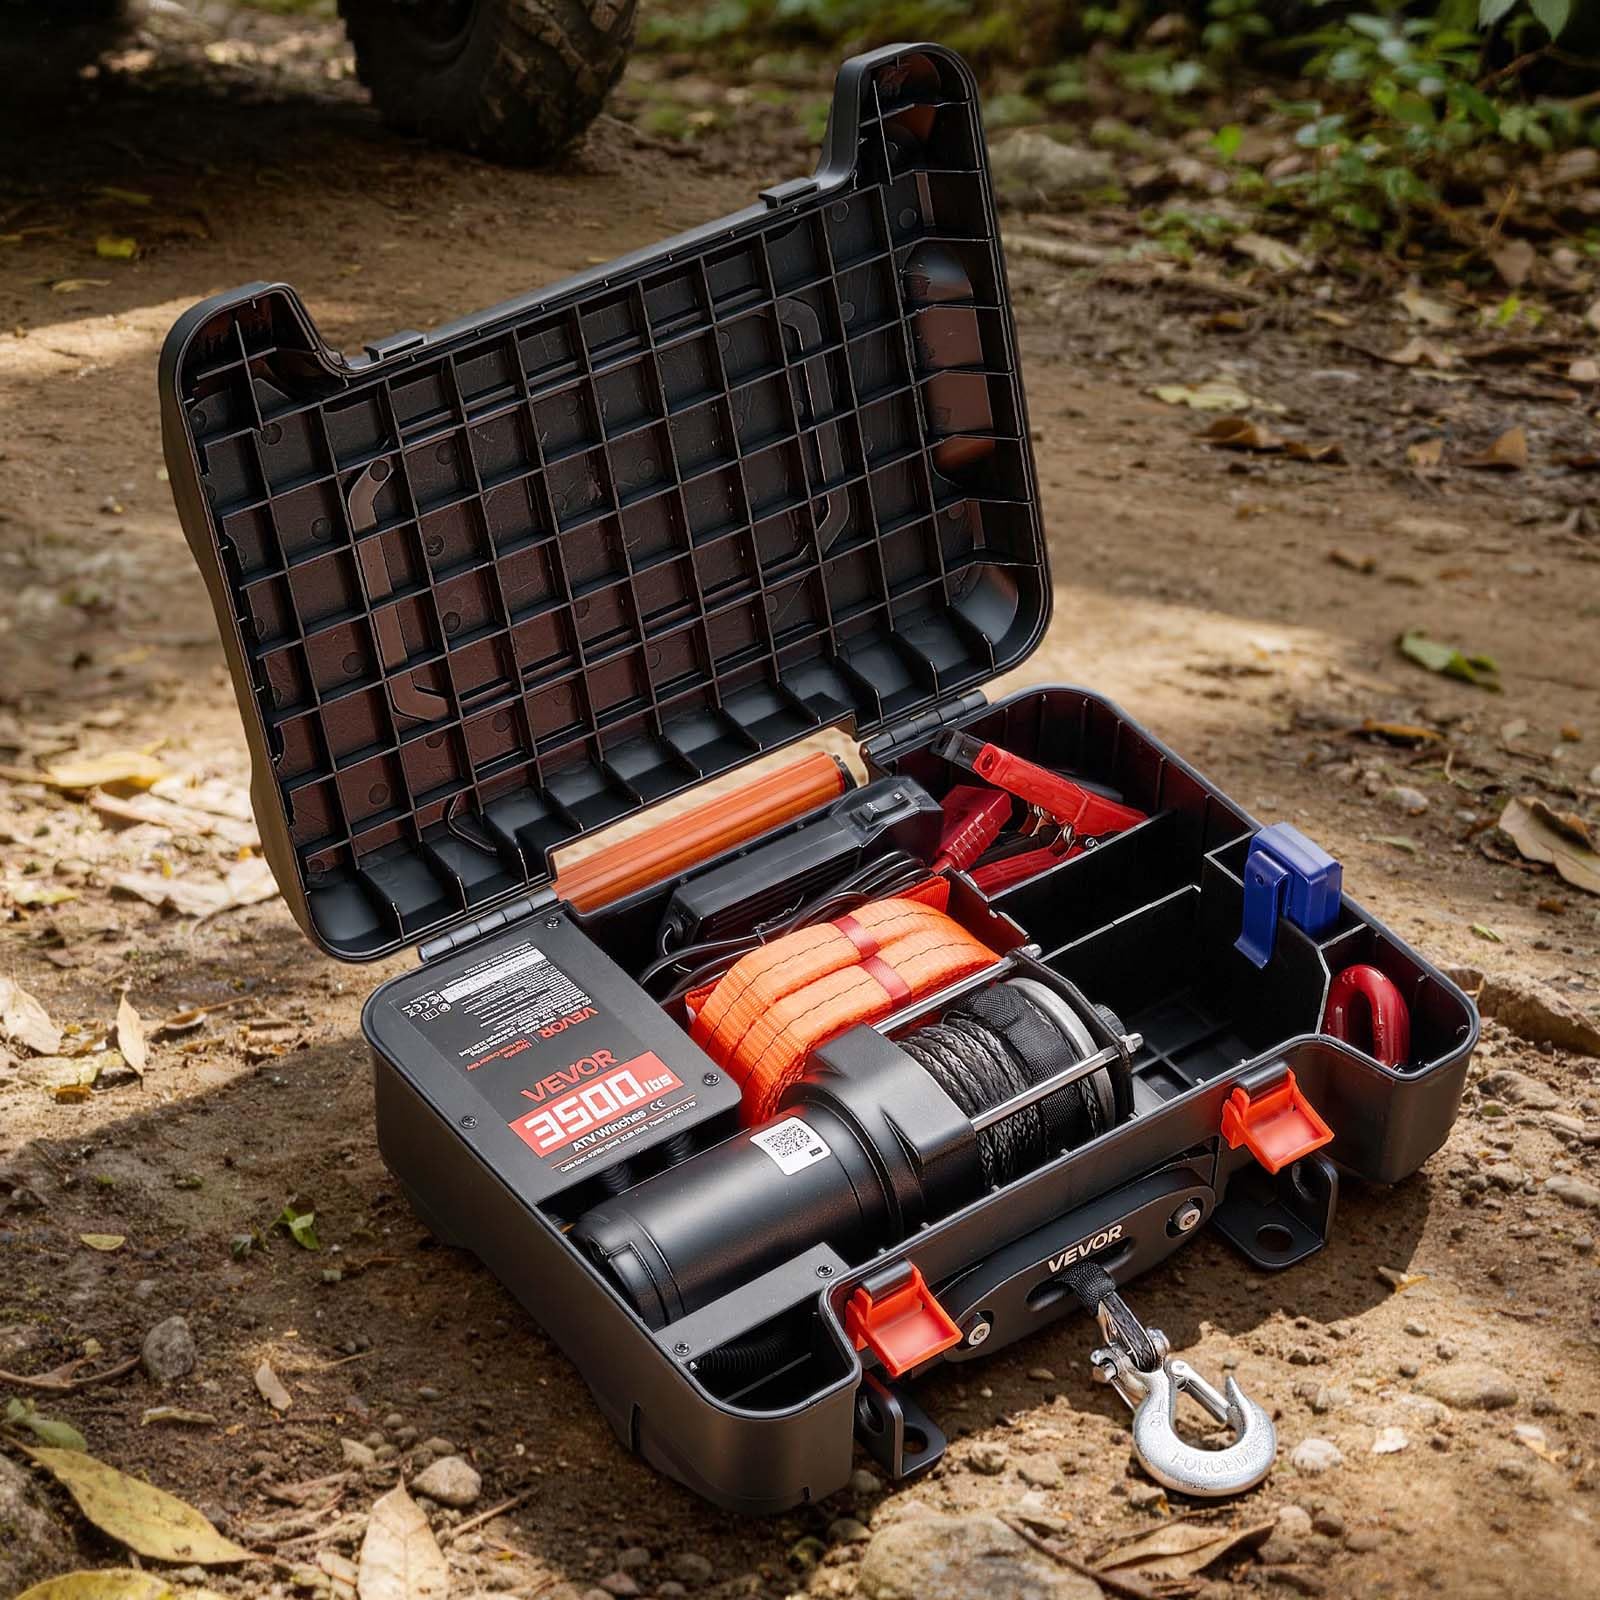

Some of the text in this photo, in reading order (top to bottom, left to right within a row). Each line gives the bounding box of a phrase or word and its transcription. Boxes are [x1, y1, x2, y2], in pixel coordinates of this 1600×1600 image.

[866, 802, 881, 813] OUT
[538, 1007, 599, 1039] VEVOR
[502, 1042, 532, 1058] Upgrade
[520, 1048, 618, 1103] VEVOR
[524, 1070, 673, 1149] 3500 lbs
[571, 1131, 598, 1152] ATV
[597, 1110, 647, 1138] Winches
[1048, 1224, 1123, 1272] VEVOR
